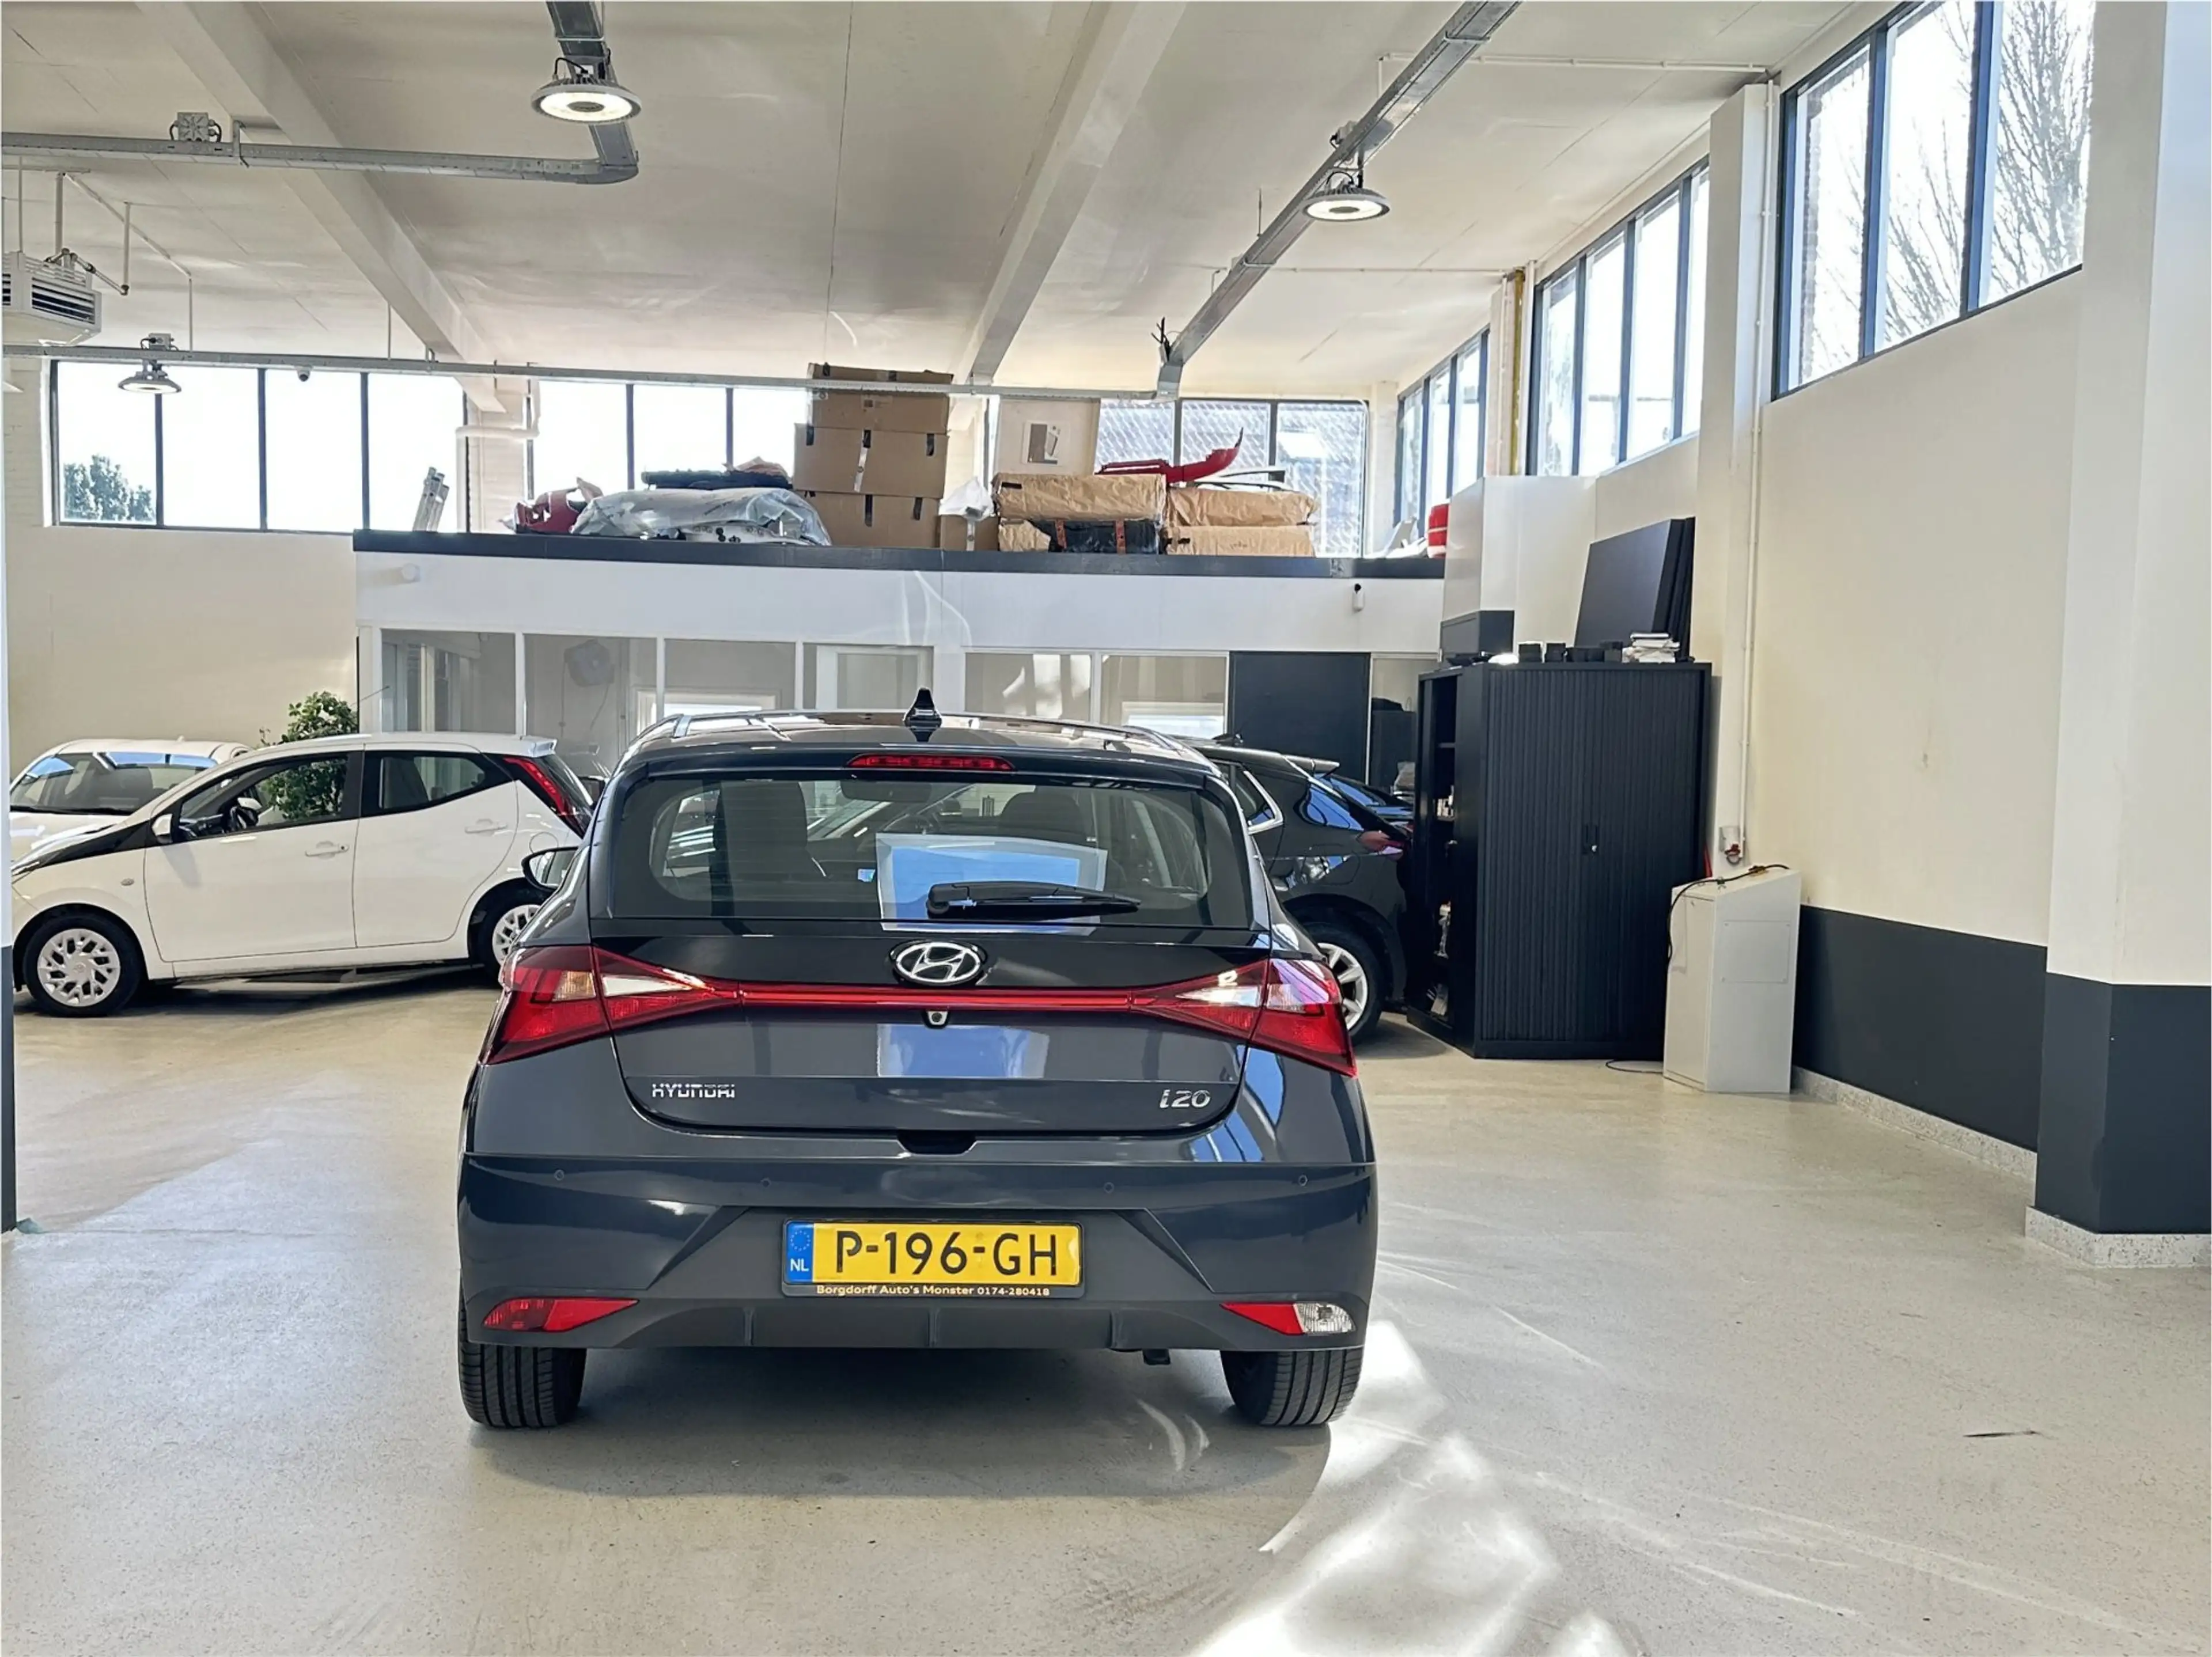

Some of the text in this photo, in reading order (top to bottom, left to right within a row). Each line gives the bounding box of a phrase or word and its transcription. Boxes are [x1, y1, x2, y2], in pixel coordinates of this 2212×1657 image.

[652, 1083, 736, 1098] HYUNDAI
[1160, 1089, 1211, 1108] i20
[836, 1230, 1056, 1276] P-196-GH
[790, 1259, 809, 1272] NL
[817, 1285, 1050, 1296] Borgdorff Auto's Monster 0174-280418
